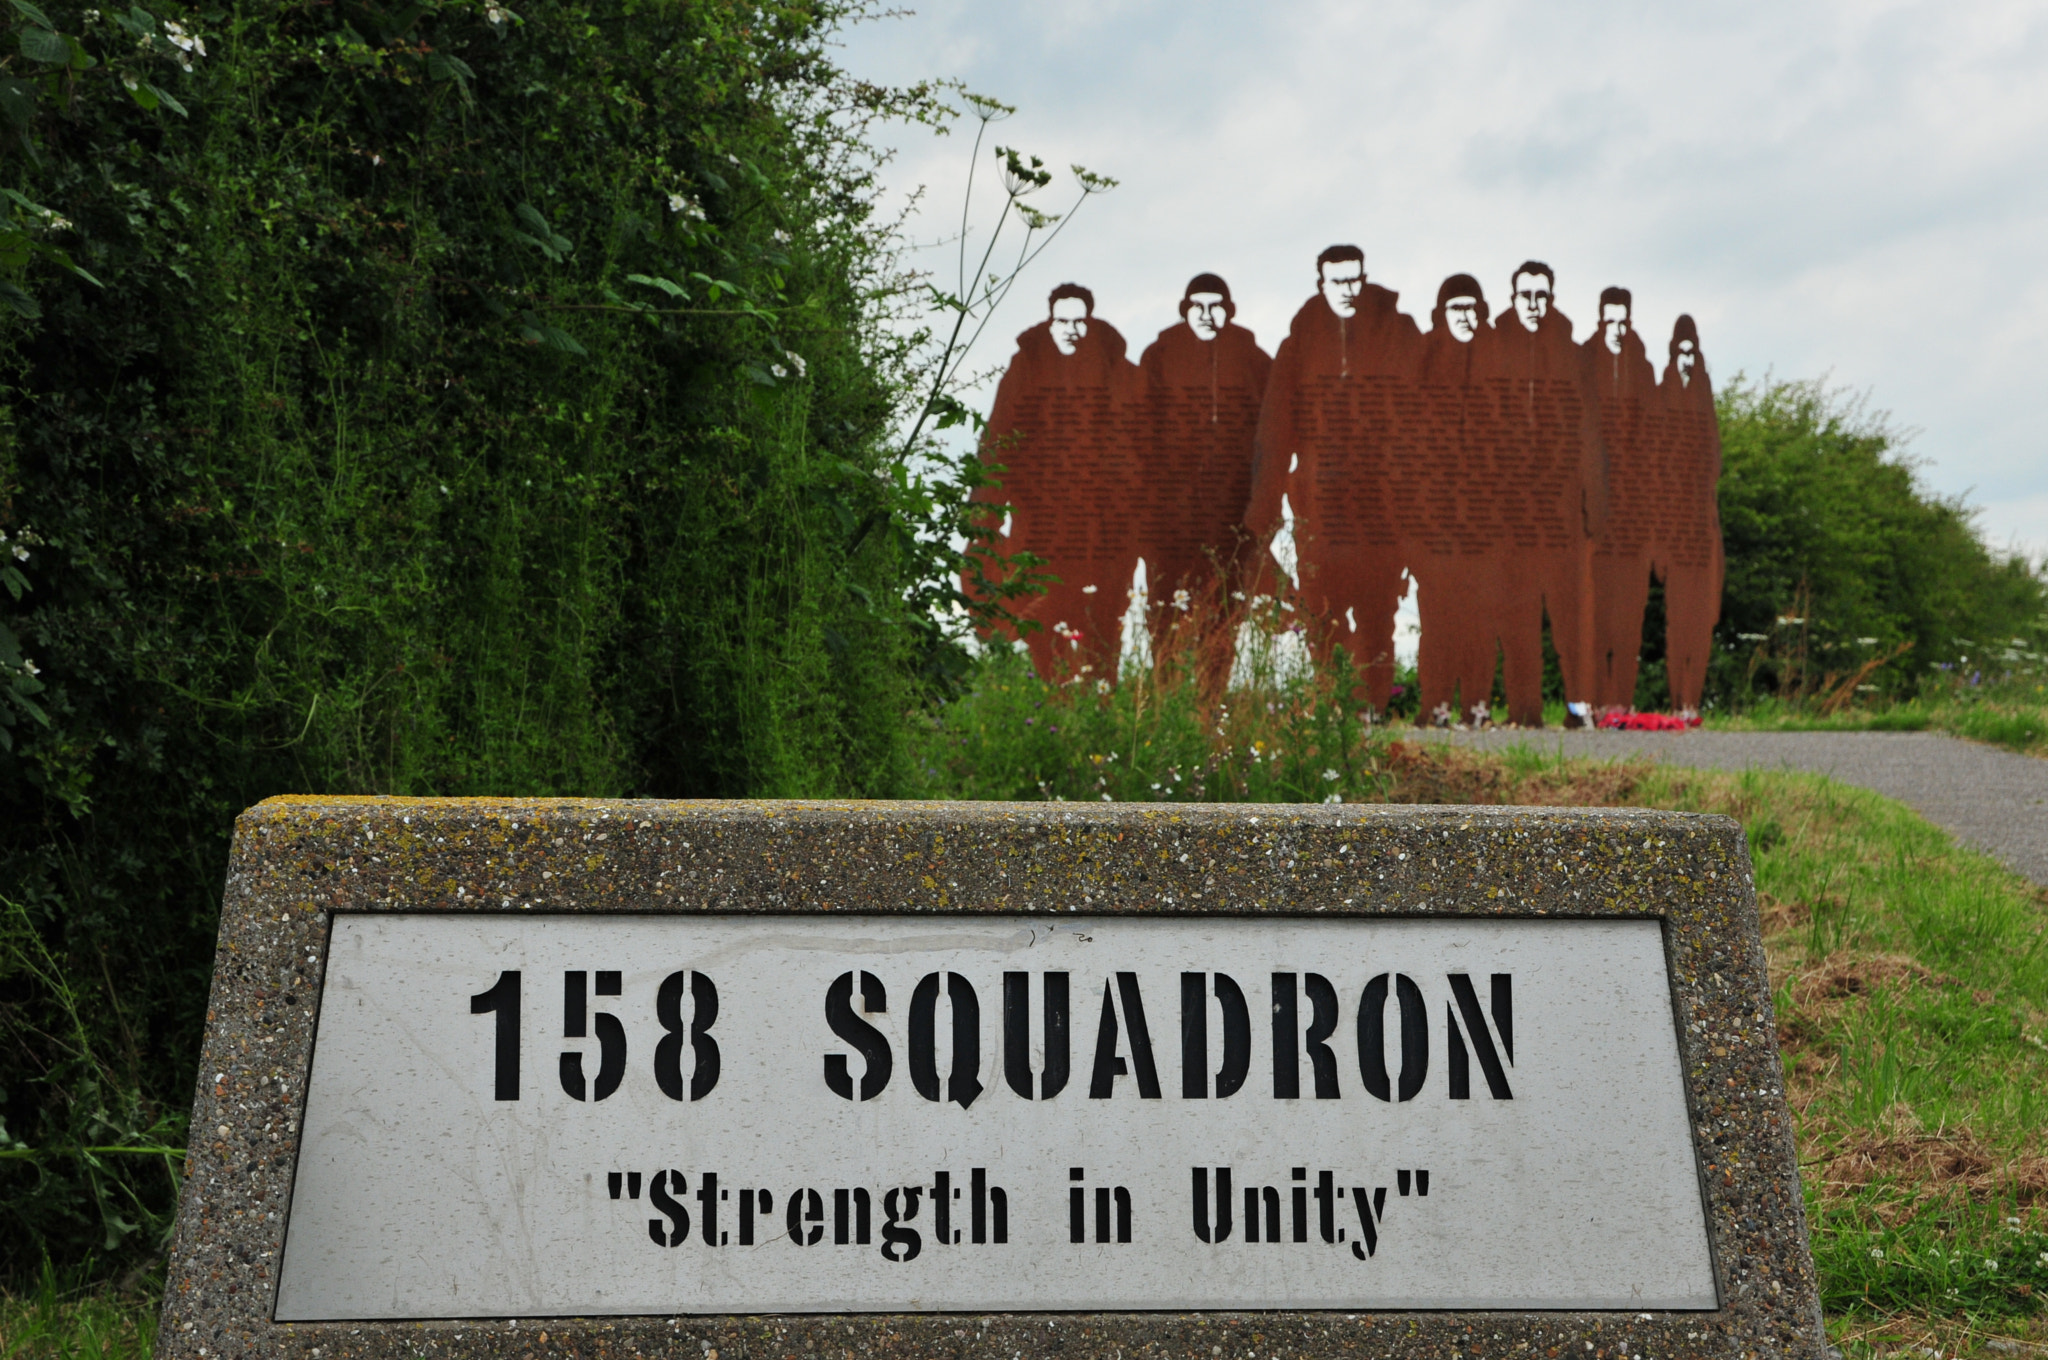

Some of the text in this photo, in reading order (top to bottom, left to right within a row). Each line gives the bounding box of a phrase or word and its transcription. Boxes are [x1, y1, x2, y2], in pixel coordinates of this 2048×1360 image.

[470, 970, 1514, 1111] 158 SQUADRON
[607, 1166, 1430, 1263] "Strength in Unity"
